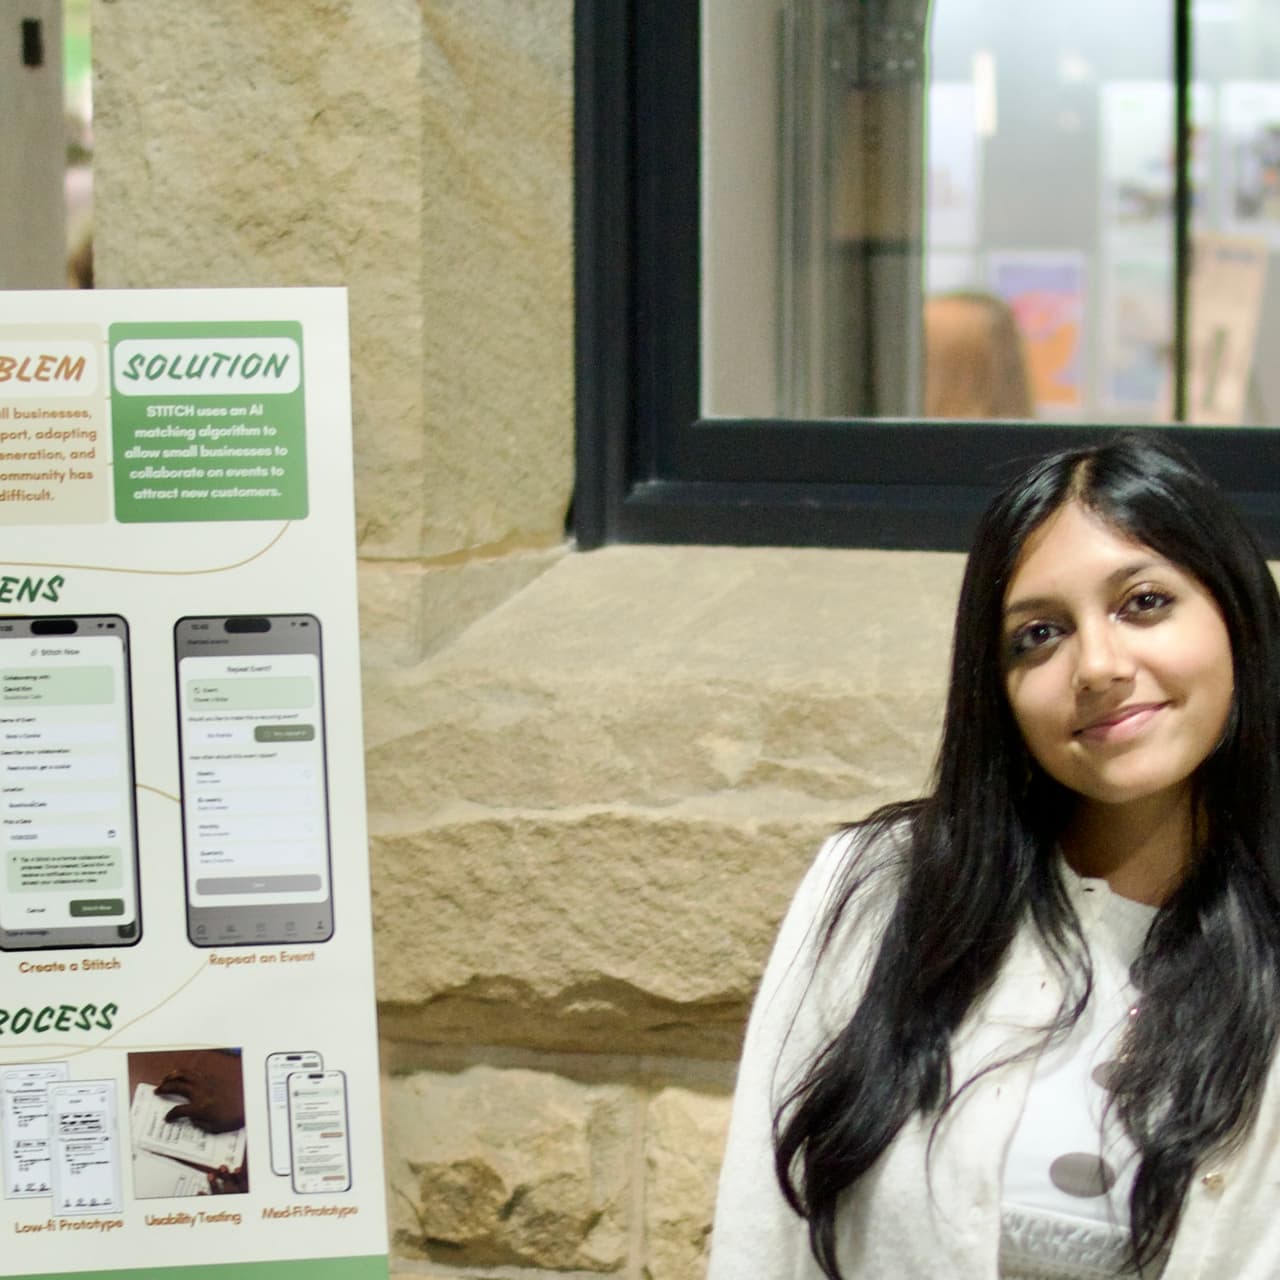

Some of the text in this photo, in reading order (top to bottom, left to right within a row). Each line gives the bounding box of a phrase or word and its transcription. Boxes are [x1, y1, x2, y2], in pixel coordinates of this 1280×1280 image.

[122, 352, 290, 381] SOLUTION
[14, 407, 92, 420] businesses,
[146, 404, 263, 417] STITCH uses an AI
[35, 427, 97, 442] adapting
[134, 424, 277, 440] matching algorithm to
[70, 447, 96, 459] and
[124, 445, 288, 458] allow small businesses to
[69, 467, 93, 480] has
[129, 466, 284, 479] collaborate on events to
[133, 487, 282, 500] attract new customers.
[19, 957, 121, 973] Create a Stitch
[209, 951, 315, 968] Repeat an Event
[145, 1210, 242, 1228] Usability Testing
[303, 1205, 359, 1219] Prototype
[59, 1218, 124, 1233] Prototype
